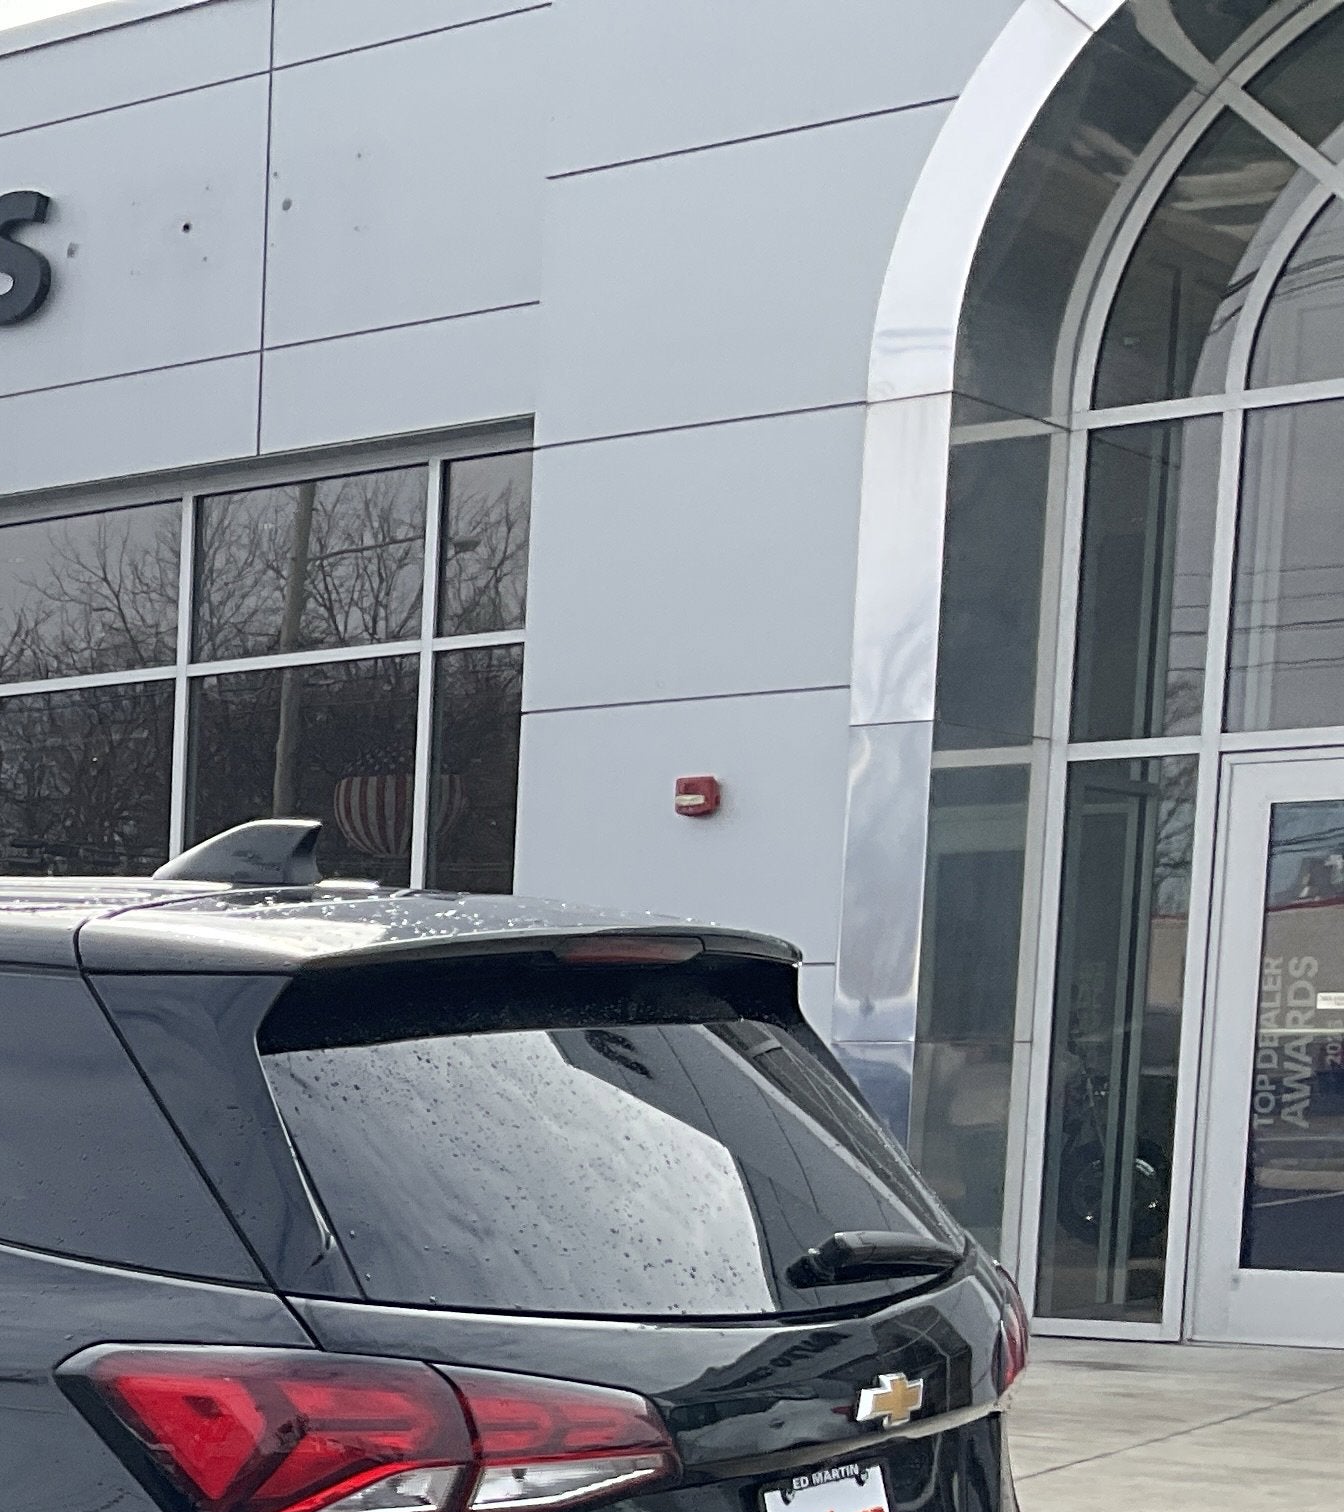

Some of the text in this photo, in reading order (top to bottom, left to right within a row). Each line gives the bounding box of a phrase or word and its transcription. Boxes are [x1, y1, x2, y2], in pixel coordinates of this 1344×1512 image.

[1253, 956, 1283, 1130] TOP DEALER
[1280, 955, 1319, 1129] AWARDS
[792, 1463, 860, 1490] ED MARTIN
